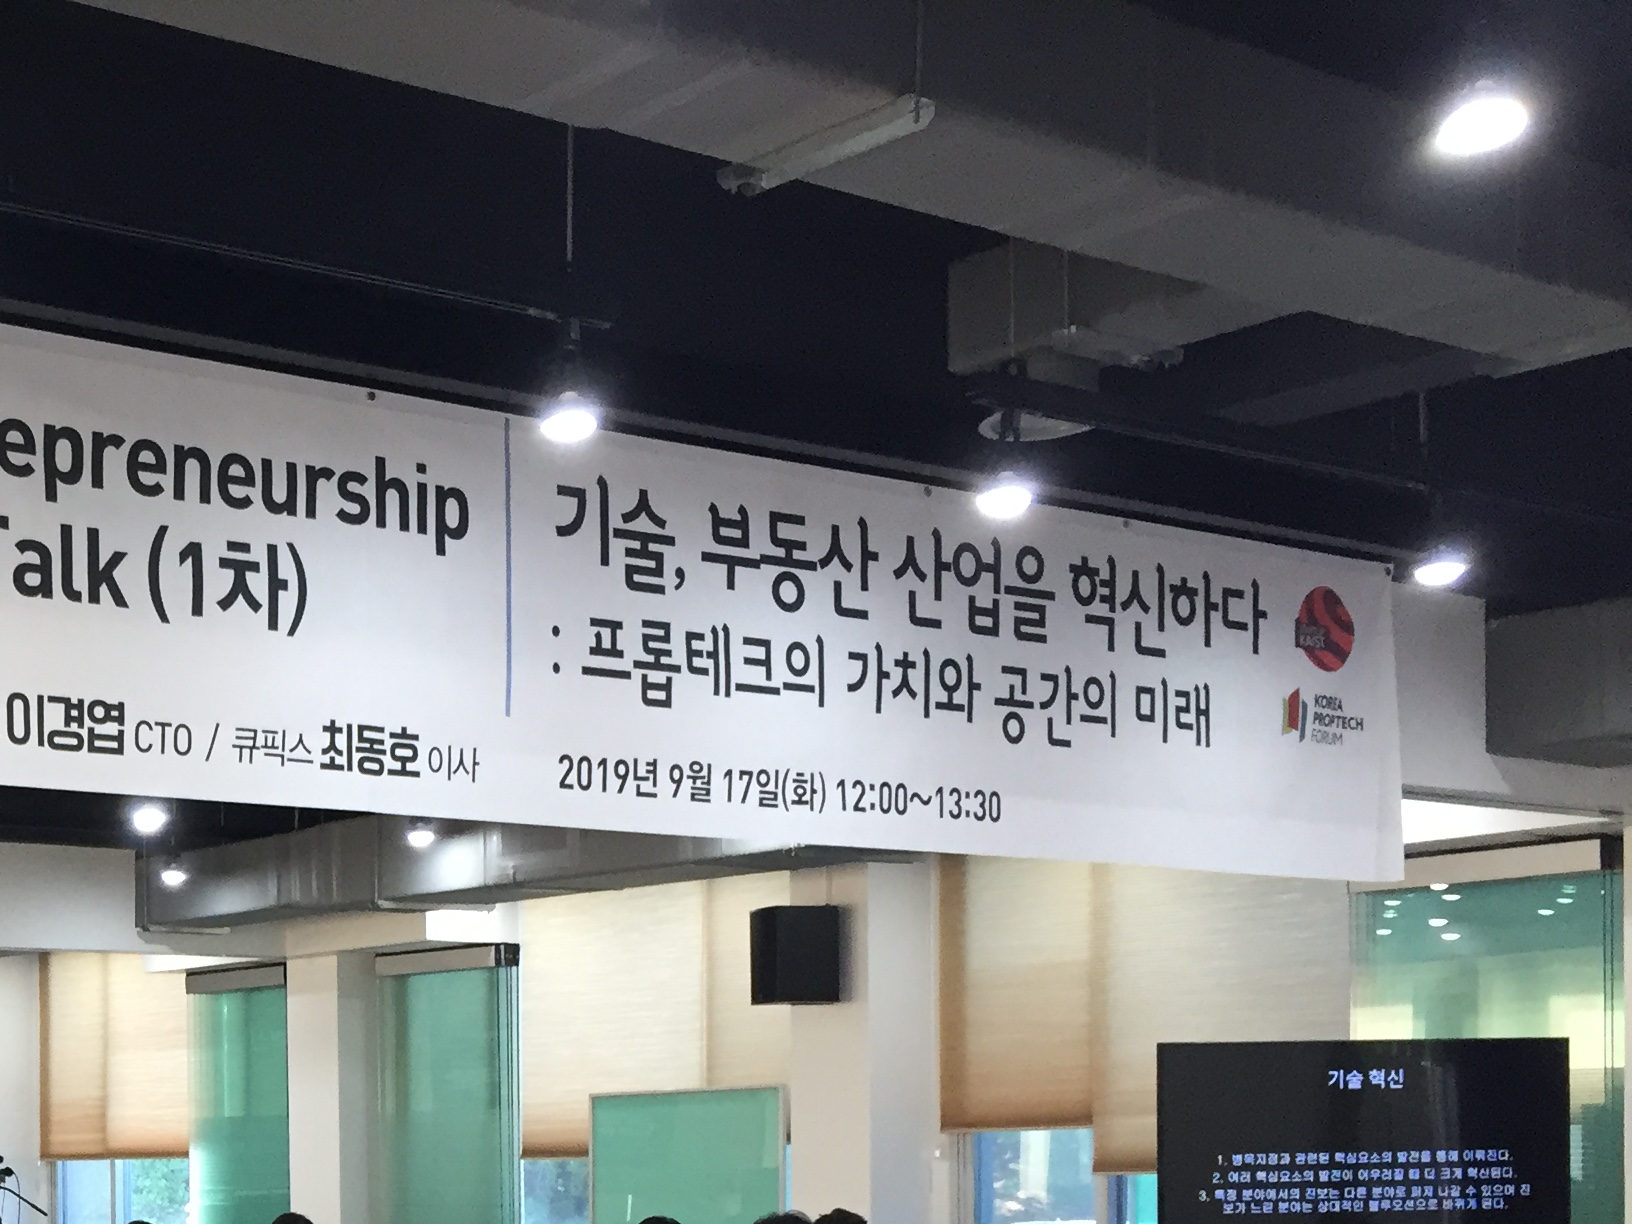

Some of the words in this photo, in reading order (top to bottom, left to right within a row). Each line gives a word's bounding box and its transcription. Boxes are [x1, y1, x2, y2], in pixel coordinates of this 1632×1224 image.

[555, 474, 686, 595] 기술,
[701, 502, 879, 620] 부동산
[893, 527, 1056, 644] 산업을
[1069, 555, 1268, 659] 혁신하다
[148, 525, 308, 637] (1차)
[582, 617, 825, 709] 프롭테크의
[847, 642, 982, 723] 가치와
[994, 665, 1116, 747] 공간의
[1136, 677, 1211, 747] 미래
[1314, 694, 1344, 712] KOREA
[1313, 711, 1364, 731] PROPTECH
[6, 692, 125, 756] 이경엽
[134, 720, 193, 756] CTO
[232, 727, 314, 766] 큐픽스
[320, 719, 421, 778] 최동호
[428, 745, 480, 783] 이사
[1311, 729, 1343, 745] FORUM
[558, 754, 658, 798] 2019년
[669, 761, 711, 803] 9월
[723, 768, 826, 813] 17일(화)
[836, 779, 1001, 823] 12:00~13:30
[1328, 1069, 1364, 1090] 기술
[1368, 1069, 1405, 1090] 혁신
[1228, 1171, 1251, 1183] 여러
[1466, 1185, 1477, 1197] 수
